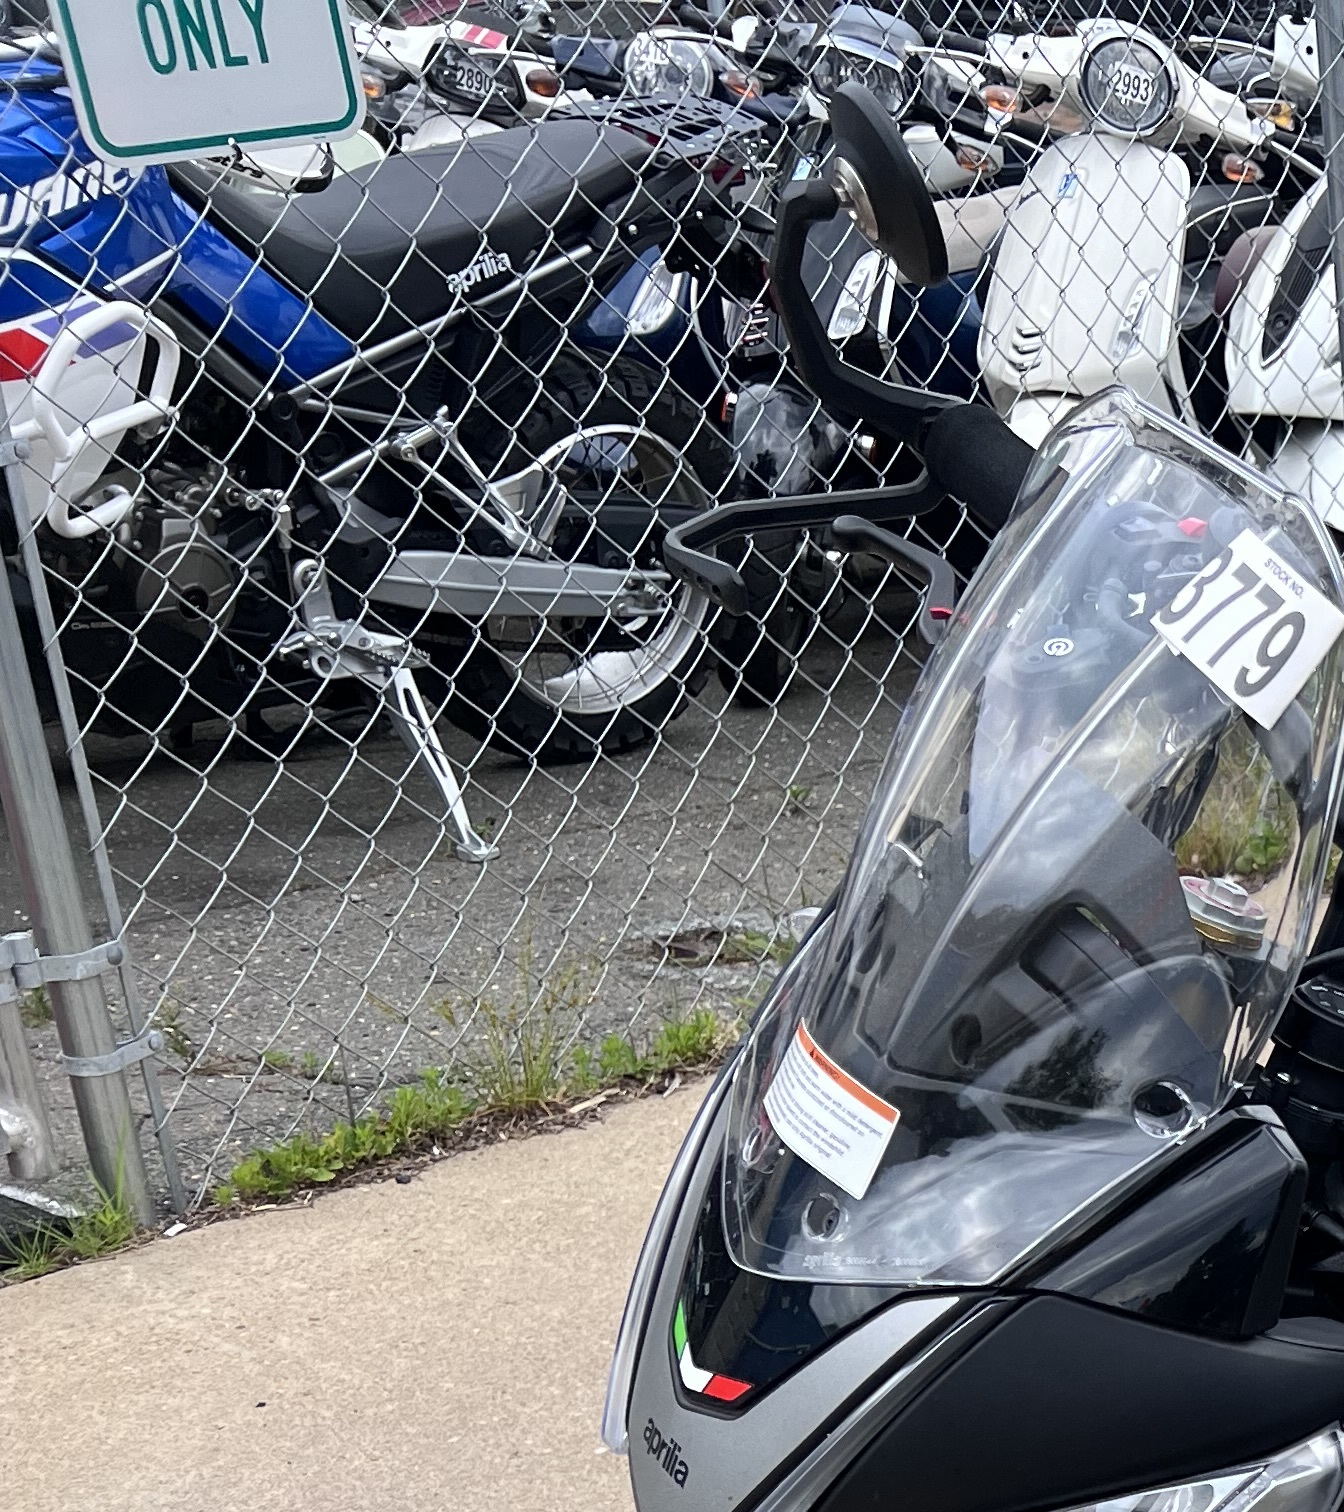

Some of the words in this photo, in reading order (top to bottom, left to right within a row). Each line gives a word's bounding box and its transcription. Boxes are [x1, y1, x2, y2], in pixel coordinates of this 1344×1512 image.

[137, 0, 269, 75] ONLY
[456, 66, 493, 94] 2890
[446, 252, 512, 293] aprilia
[1264, 557, 1292, 586] STOCK
[1159, 545, 1306, 698] 3779
[643, 1418, 689, 1489] aprilia
